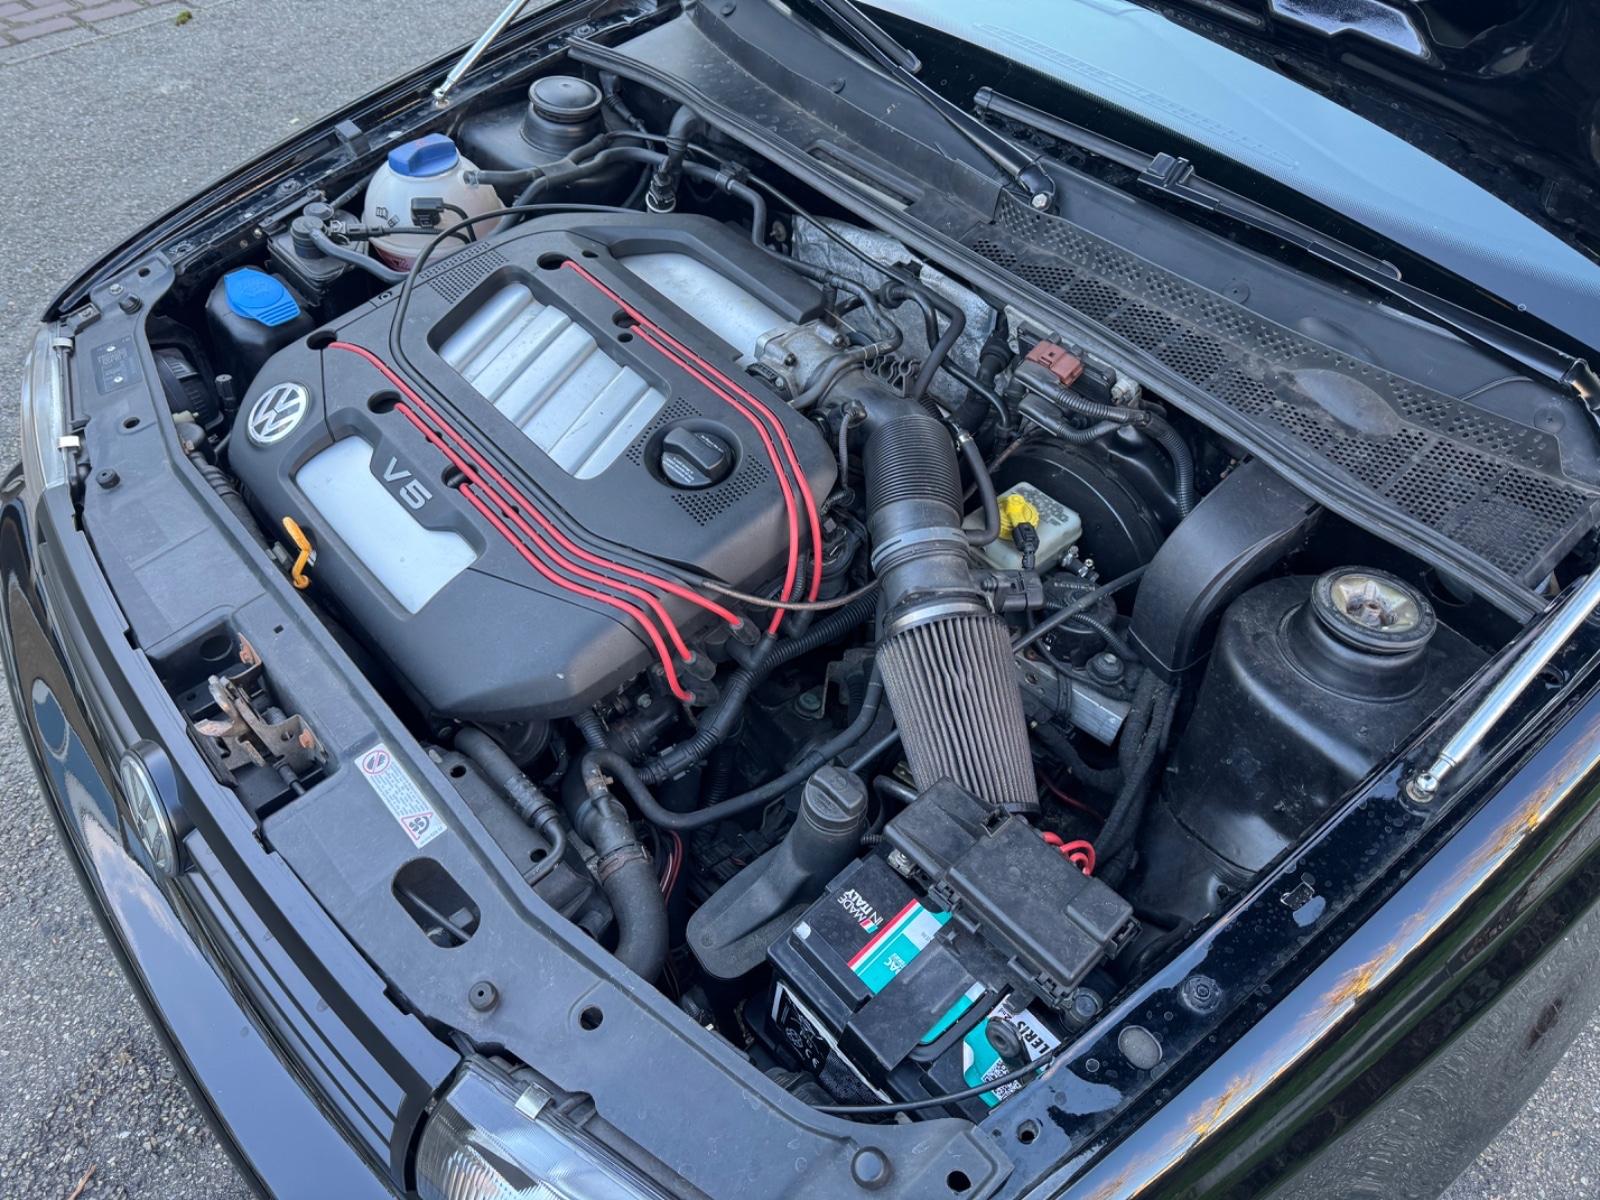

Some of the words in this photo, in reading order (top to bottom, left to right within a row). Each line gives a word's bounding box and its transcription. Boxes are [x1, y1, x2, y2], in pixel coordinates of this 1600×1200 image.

[248, 382, 307, 442] VW
[383, 457, 432, 509] V5
[837, 895, 867, 922] MADE
[844, 888, 873, 915] ITALY
[869, 911, 884, 926] IN
